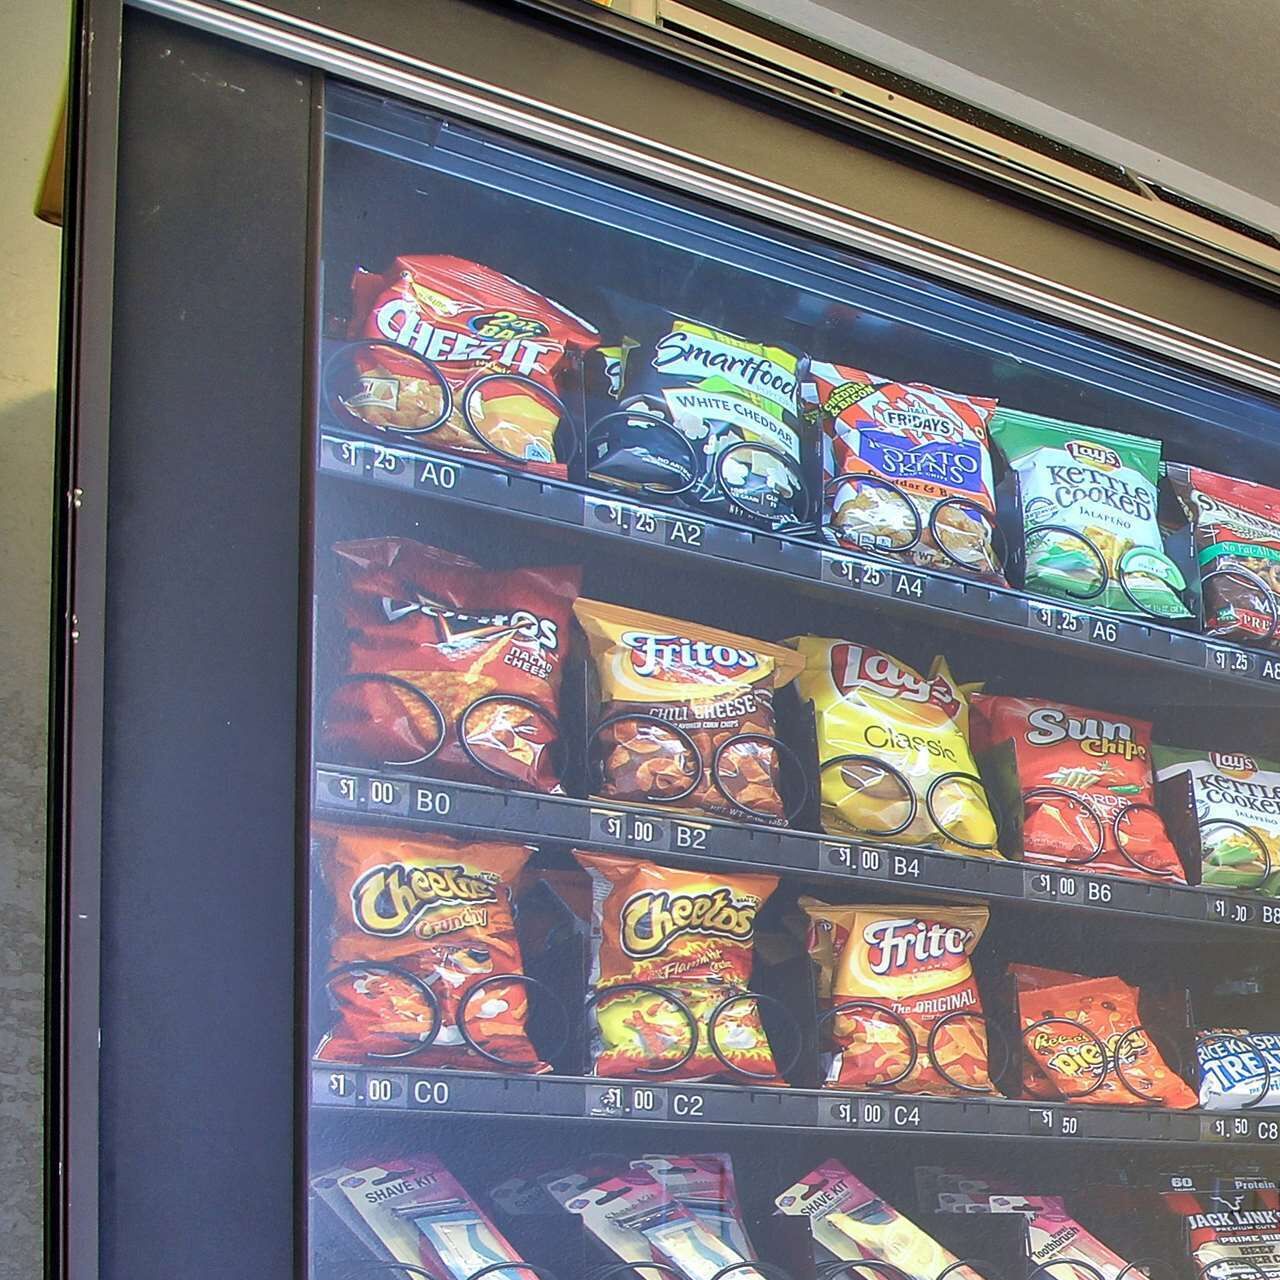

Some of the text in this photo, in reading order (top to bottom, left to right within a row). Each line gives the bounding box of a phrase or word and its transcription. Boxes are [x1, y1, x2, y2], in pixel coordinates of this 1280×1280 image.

[652, 332, 798, 397] Smartfood
[676, 394, 794, 446] WHITE CHEDDAR
[341, 441, 456, 489] $1.25 A0
[1070, 443, 1120, 468] Lay's
[609, 505, 701, 547] $1.25 A2
[840, 564, 923, 598] $1.25 A4
[1041, 608, 1117, 642] $1.25 A6
[621, 631, 759, 677] Fritos
[1215, 650, 1249, 672] $1.25
[843, 646, 953, 704] Lay's
[649, 695, 757, 722] CHILI CHEESE
[1026, 708, 1133, 746] Sun
[863, 725, 958, 764] Classic
[1213, 752, 1257, 772] Lay's
[340, 778, 450, 815] $1.00 B0
[607, 819, 707, 850] $1.00 B2
[839, 848, 920, 878] $1.00 B4
[1039, 873, 1112, 903] $1.00 B6
[415, 907, 489, 940] Crunchy
[621, 888, 757, 960] Cheetos
[915, 988, 977, 1014] ORIGINAL
[330, 1075, 391, 1101] $1.00
[673, 1095, 703, 1116] C2
[839, 1104, 920, 1126] $1.00 C4
[1215, 1118, 1279, 1141] $1.50 C8
[365, 1173, 438, 1204] SHAVE KIT
[800, 1179, 850, 1217] SHAVE KIT
[1235, 1180, 1276, 1190] Protein
[1188, 1212, 1232, 1230] JACK
[1031, 1226, 1079, 1260] Toothbrush
[1220, 1235, 1260, 1244] PRIME
